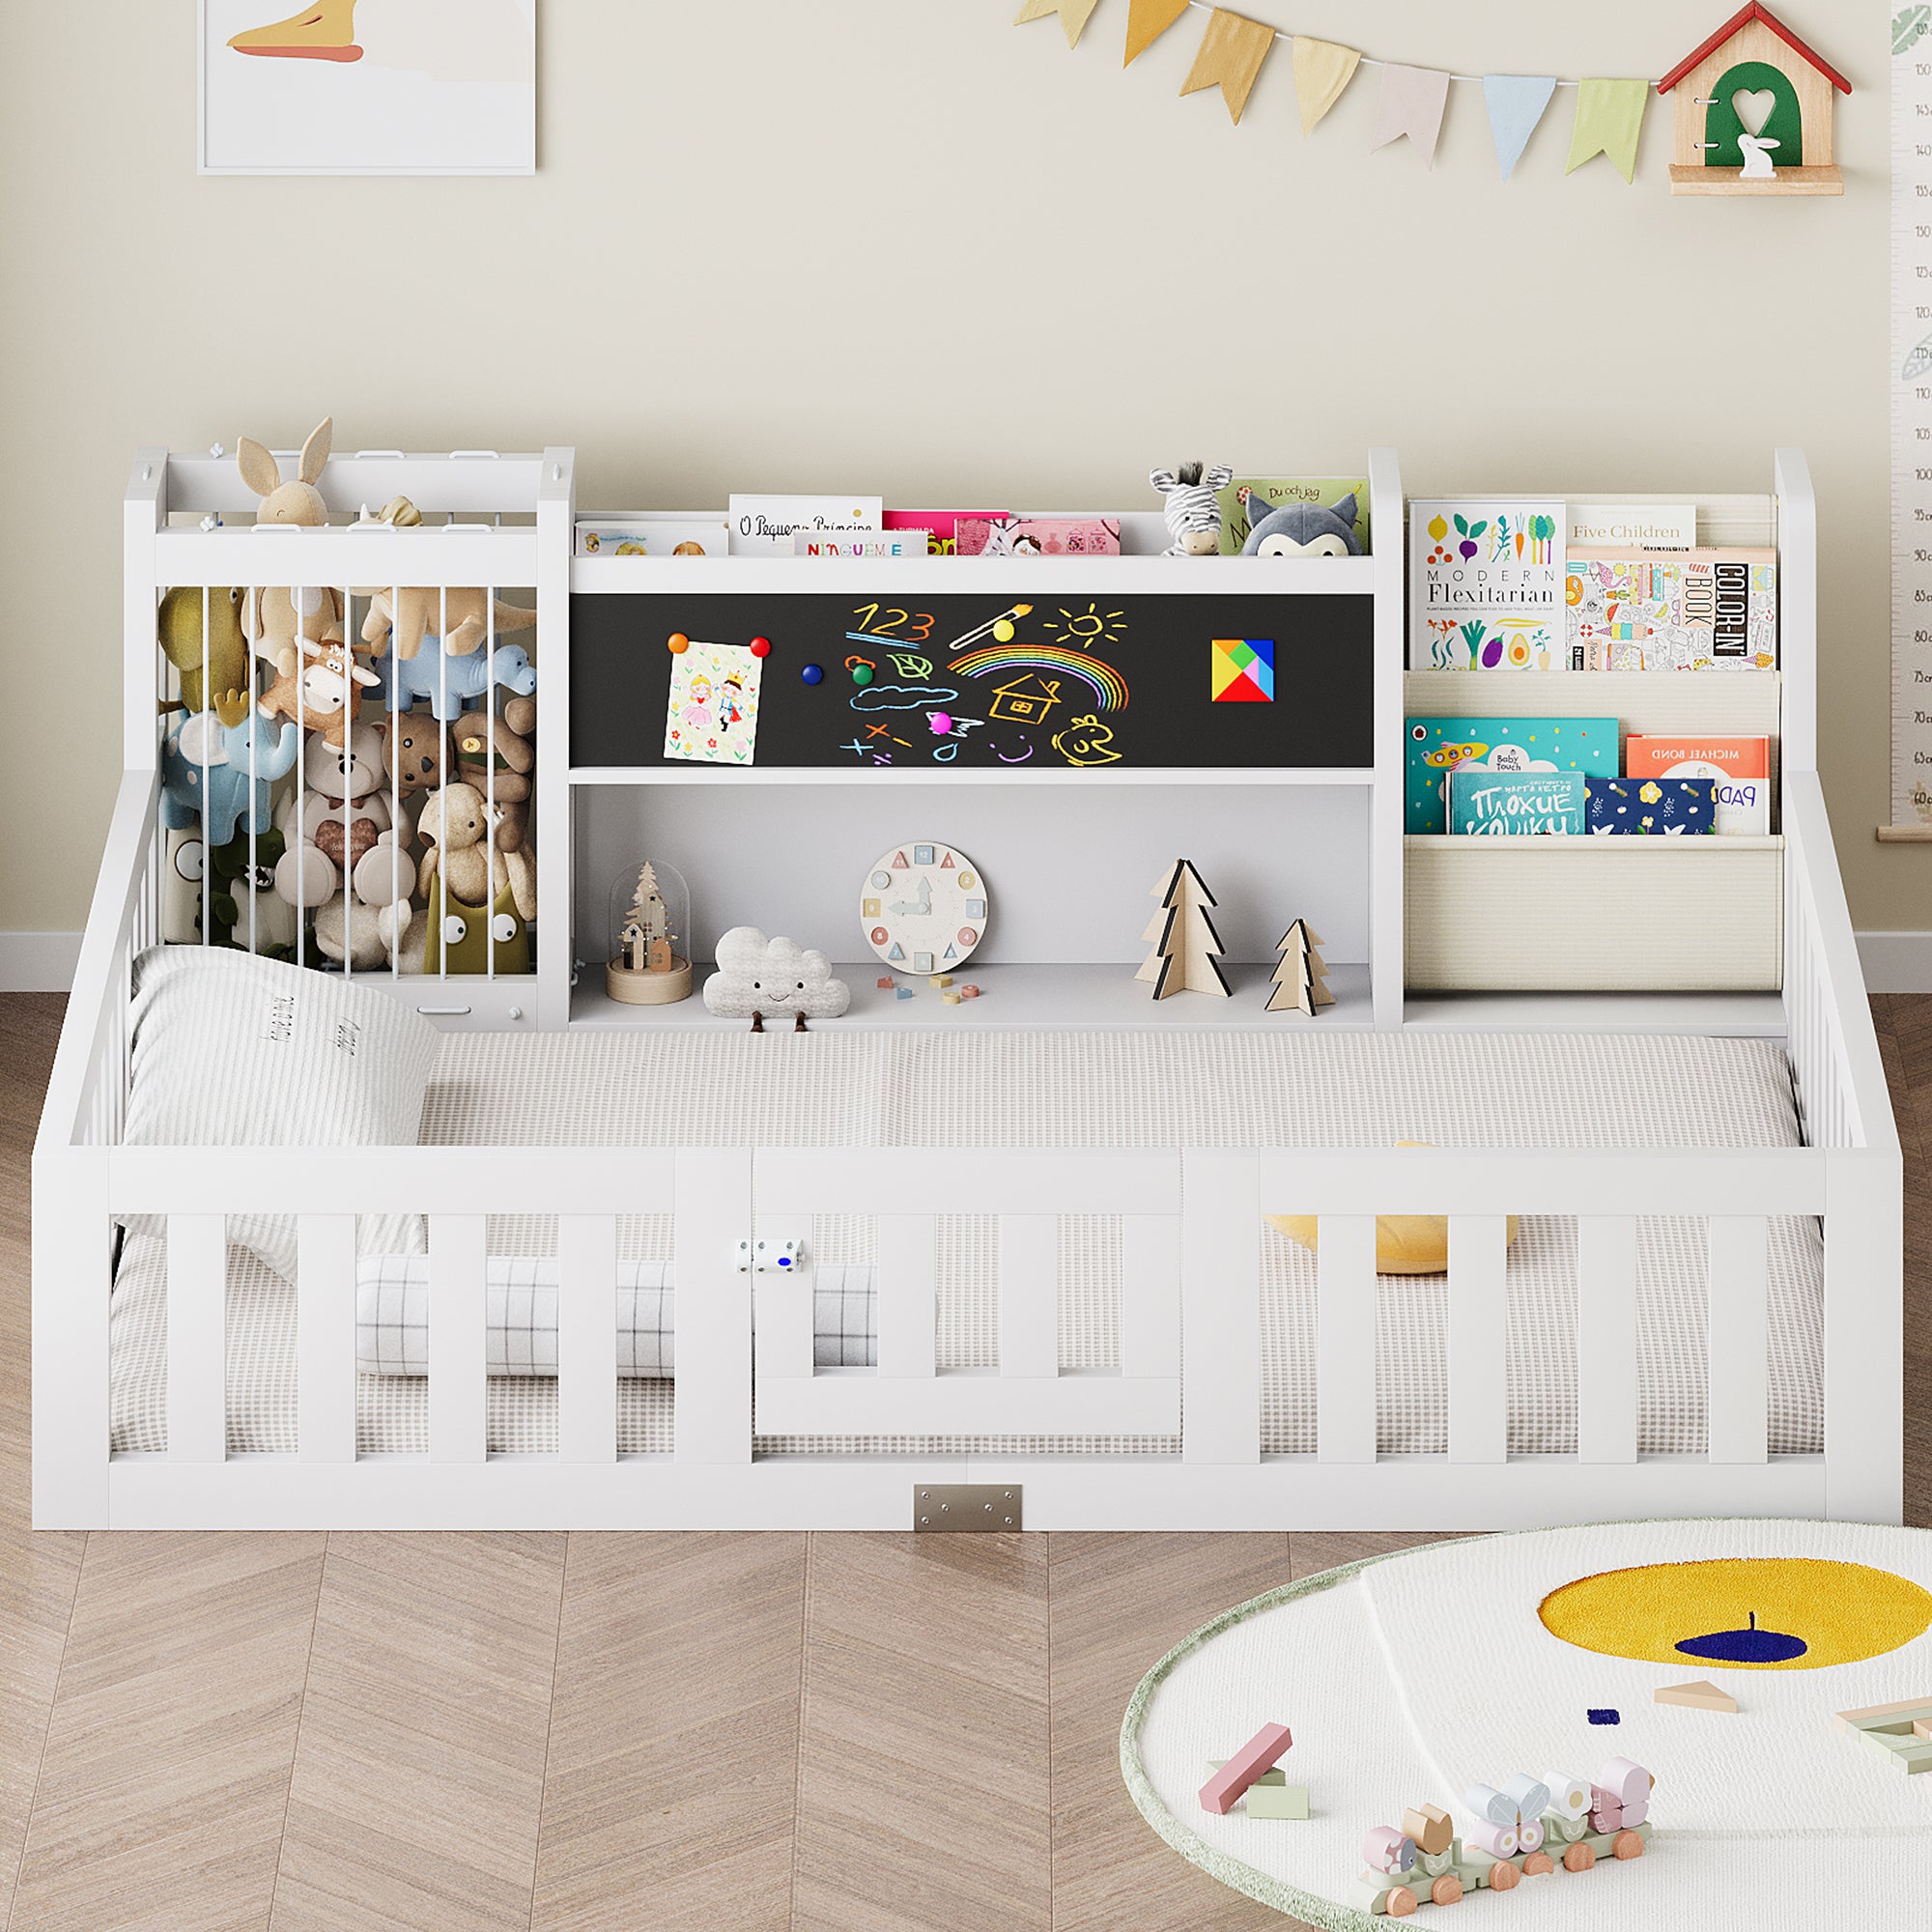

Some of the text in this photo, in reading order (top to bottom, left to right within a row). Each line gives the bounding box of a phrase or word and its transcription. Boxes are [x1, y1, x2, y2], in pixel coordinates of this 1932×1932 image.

[1916, 306, 1932, 318] 120
[1269, 485, 1320, 501] Du och jag
[740, 515, 752, 536] O
[1574, 525, 1680, 538] Five Children
[1427, 570, 1555, 582] MODERN
[1429, 583, 1553, 603] Flexitarian
[1685, 578, 1713, 626] BOOK
[1915, 711, 1932, 724] 70c
[1496, 754, 1519, 765] Baby
[1496, 762, 1521, 772] Touch
